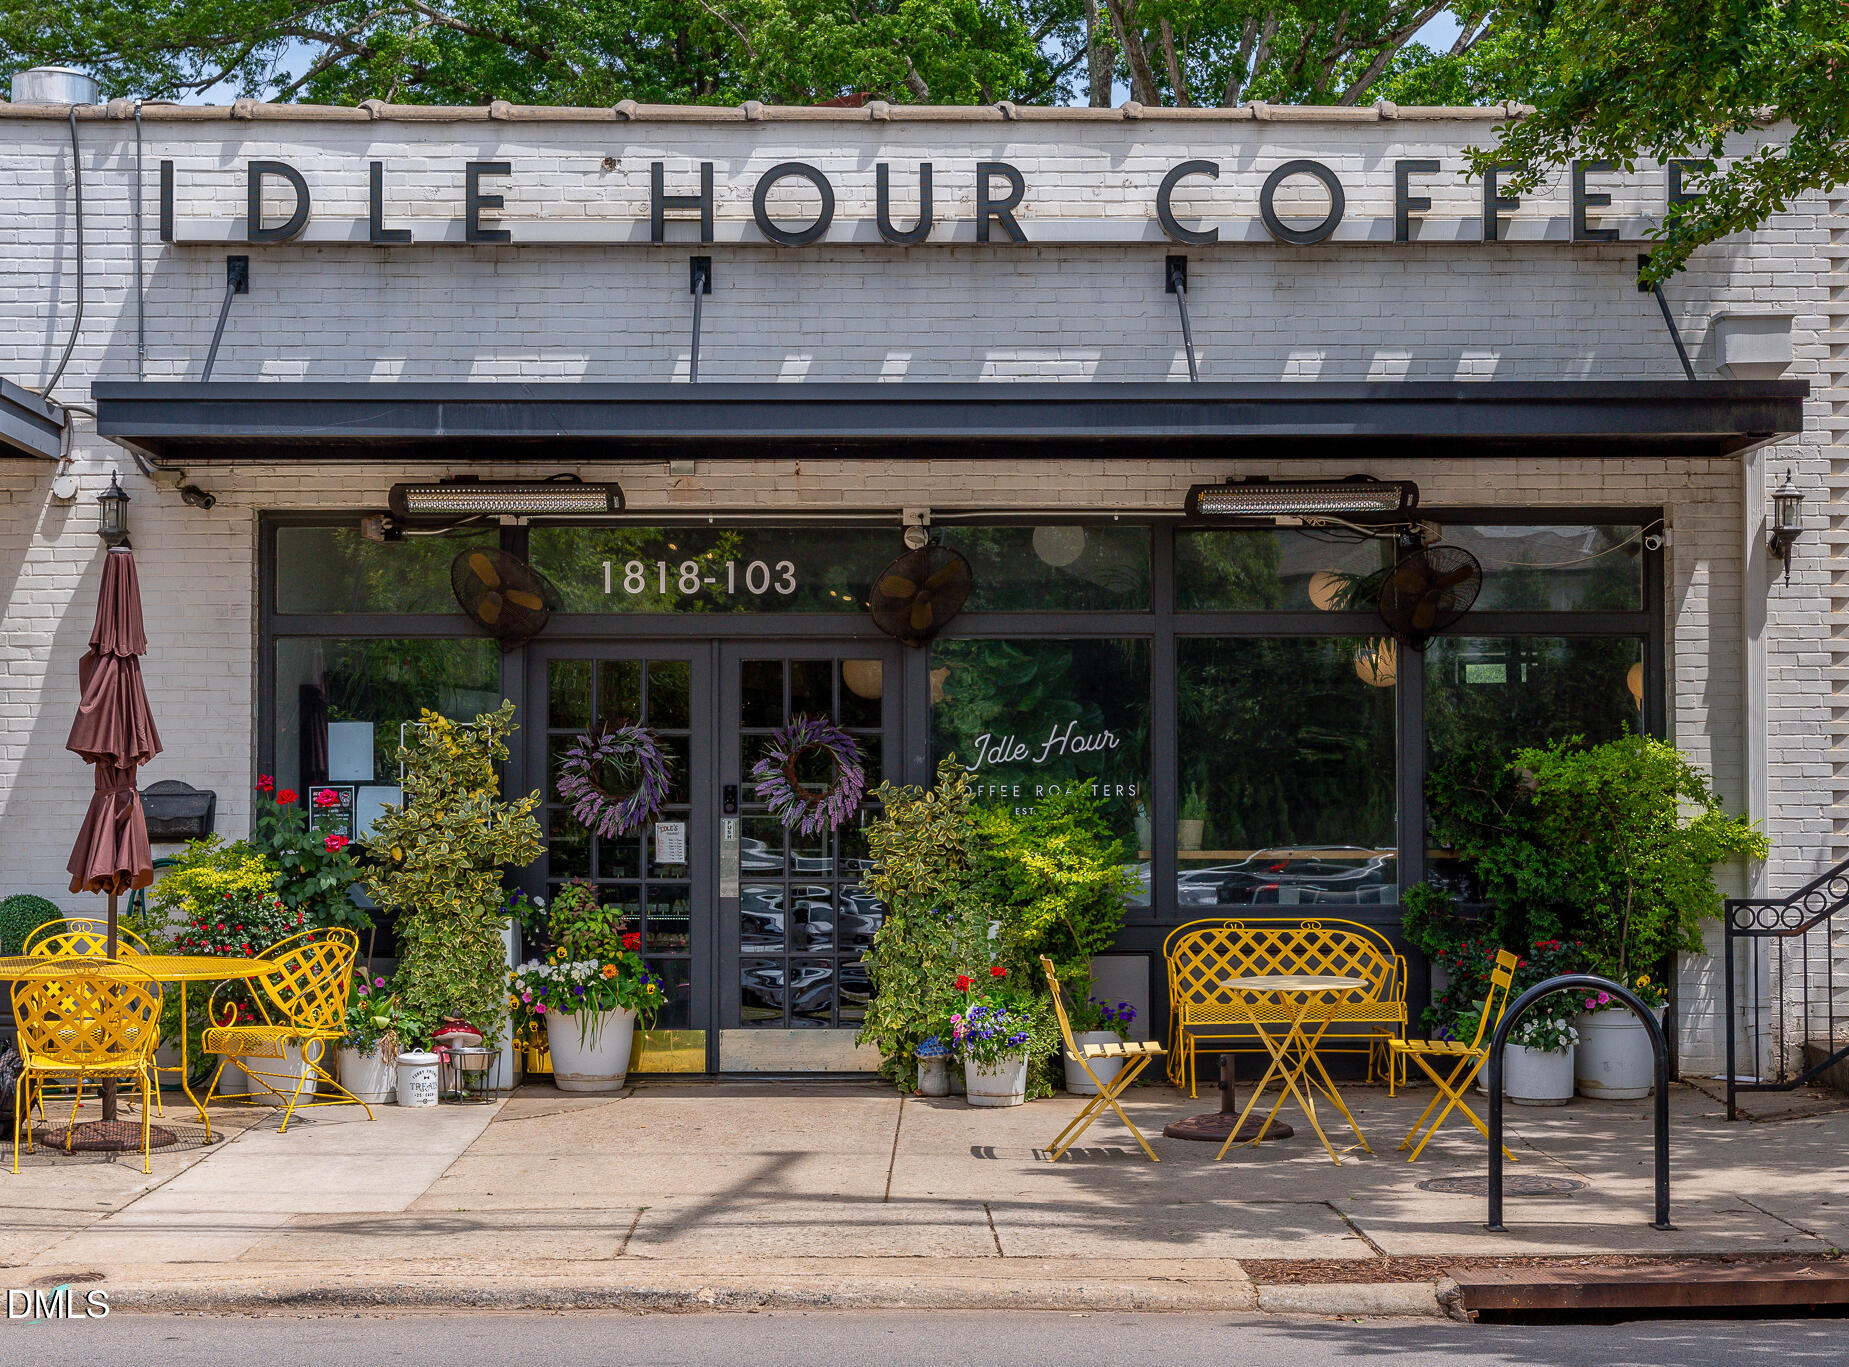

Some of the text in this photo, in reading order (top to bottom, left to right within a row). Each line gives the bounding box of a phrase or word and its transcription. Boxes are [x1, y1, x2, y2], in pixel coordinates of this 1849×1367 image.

[160, 159, 1715, 246] IDLE HOUR COFFEE
[602, 560, 797, 595] 1818-103
[965, 720, 1120, 772] Idle Hour
[961, 785, 1020, 797] OFFEE
